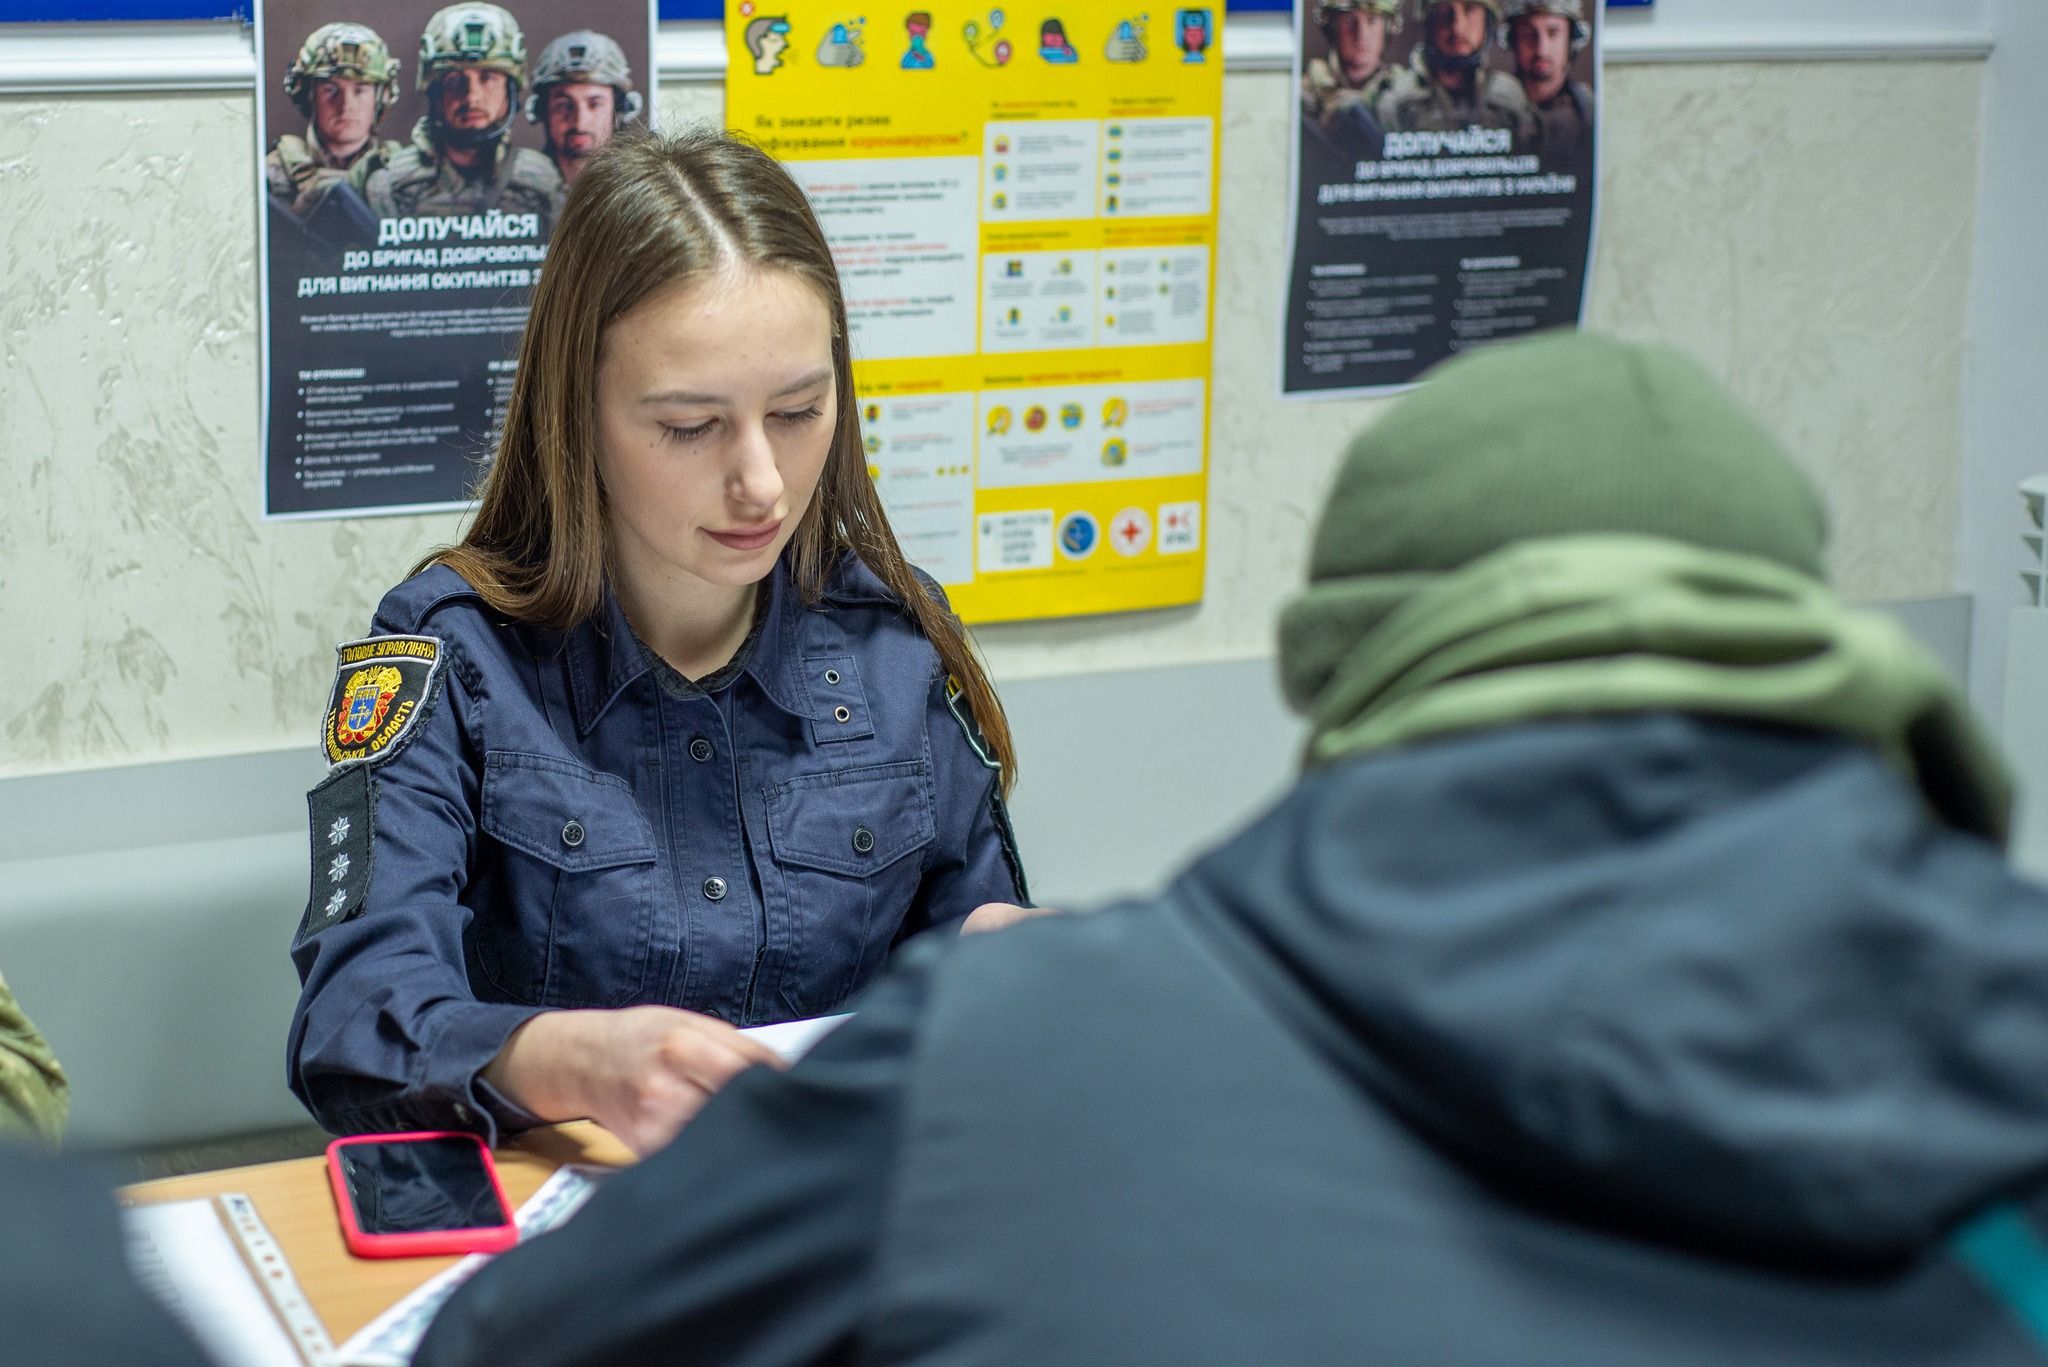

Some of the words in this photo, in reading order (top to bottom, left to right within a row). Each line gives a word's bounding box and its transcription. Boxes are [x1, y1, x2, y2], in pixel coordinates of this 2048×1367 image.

[377, 209, 539, 247] ДОЛУЧАЙСЯ
[343, 251, 371, 271] ДО
[372, 248, 439, 269] БРИГАД
[298, 276, 338, 298] ДЛЯ
[339, 272, 430, 294] ВИГНАННЯ
[431, 269, 529, 290] ОКУПАНТІВ
[343, 643, 377, 663] ГОЛОВНЕ
[376, 641, 435, 659] УПРАВЛІННЯ
[371, 700, 415, 751] ОБЛАСТЬ
